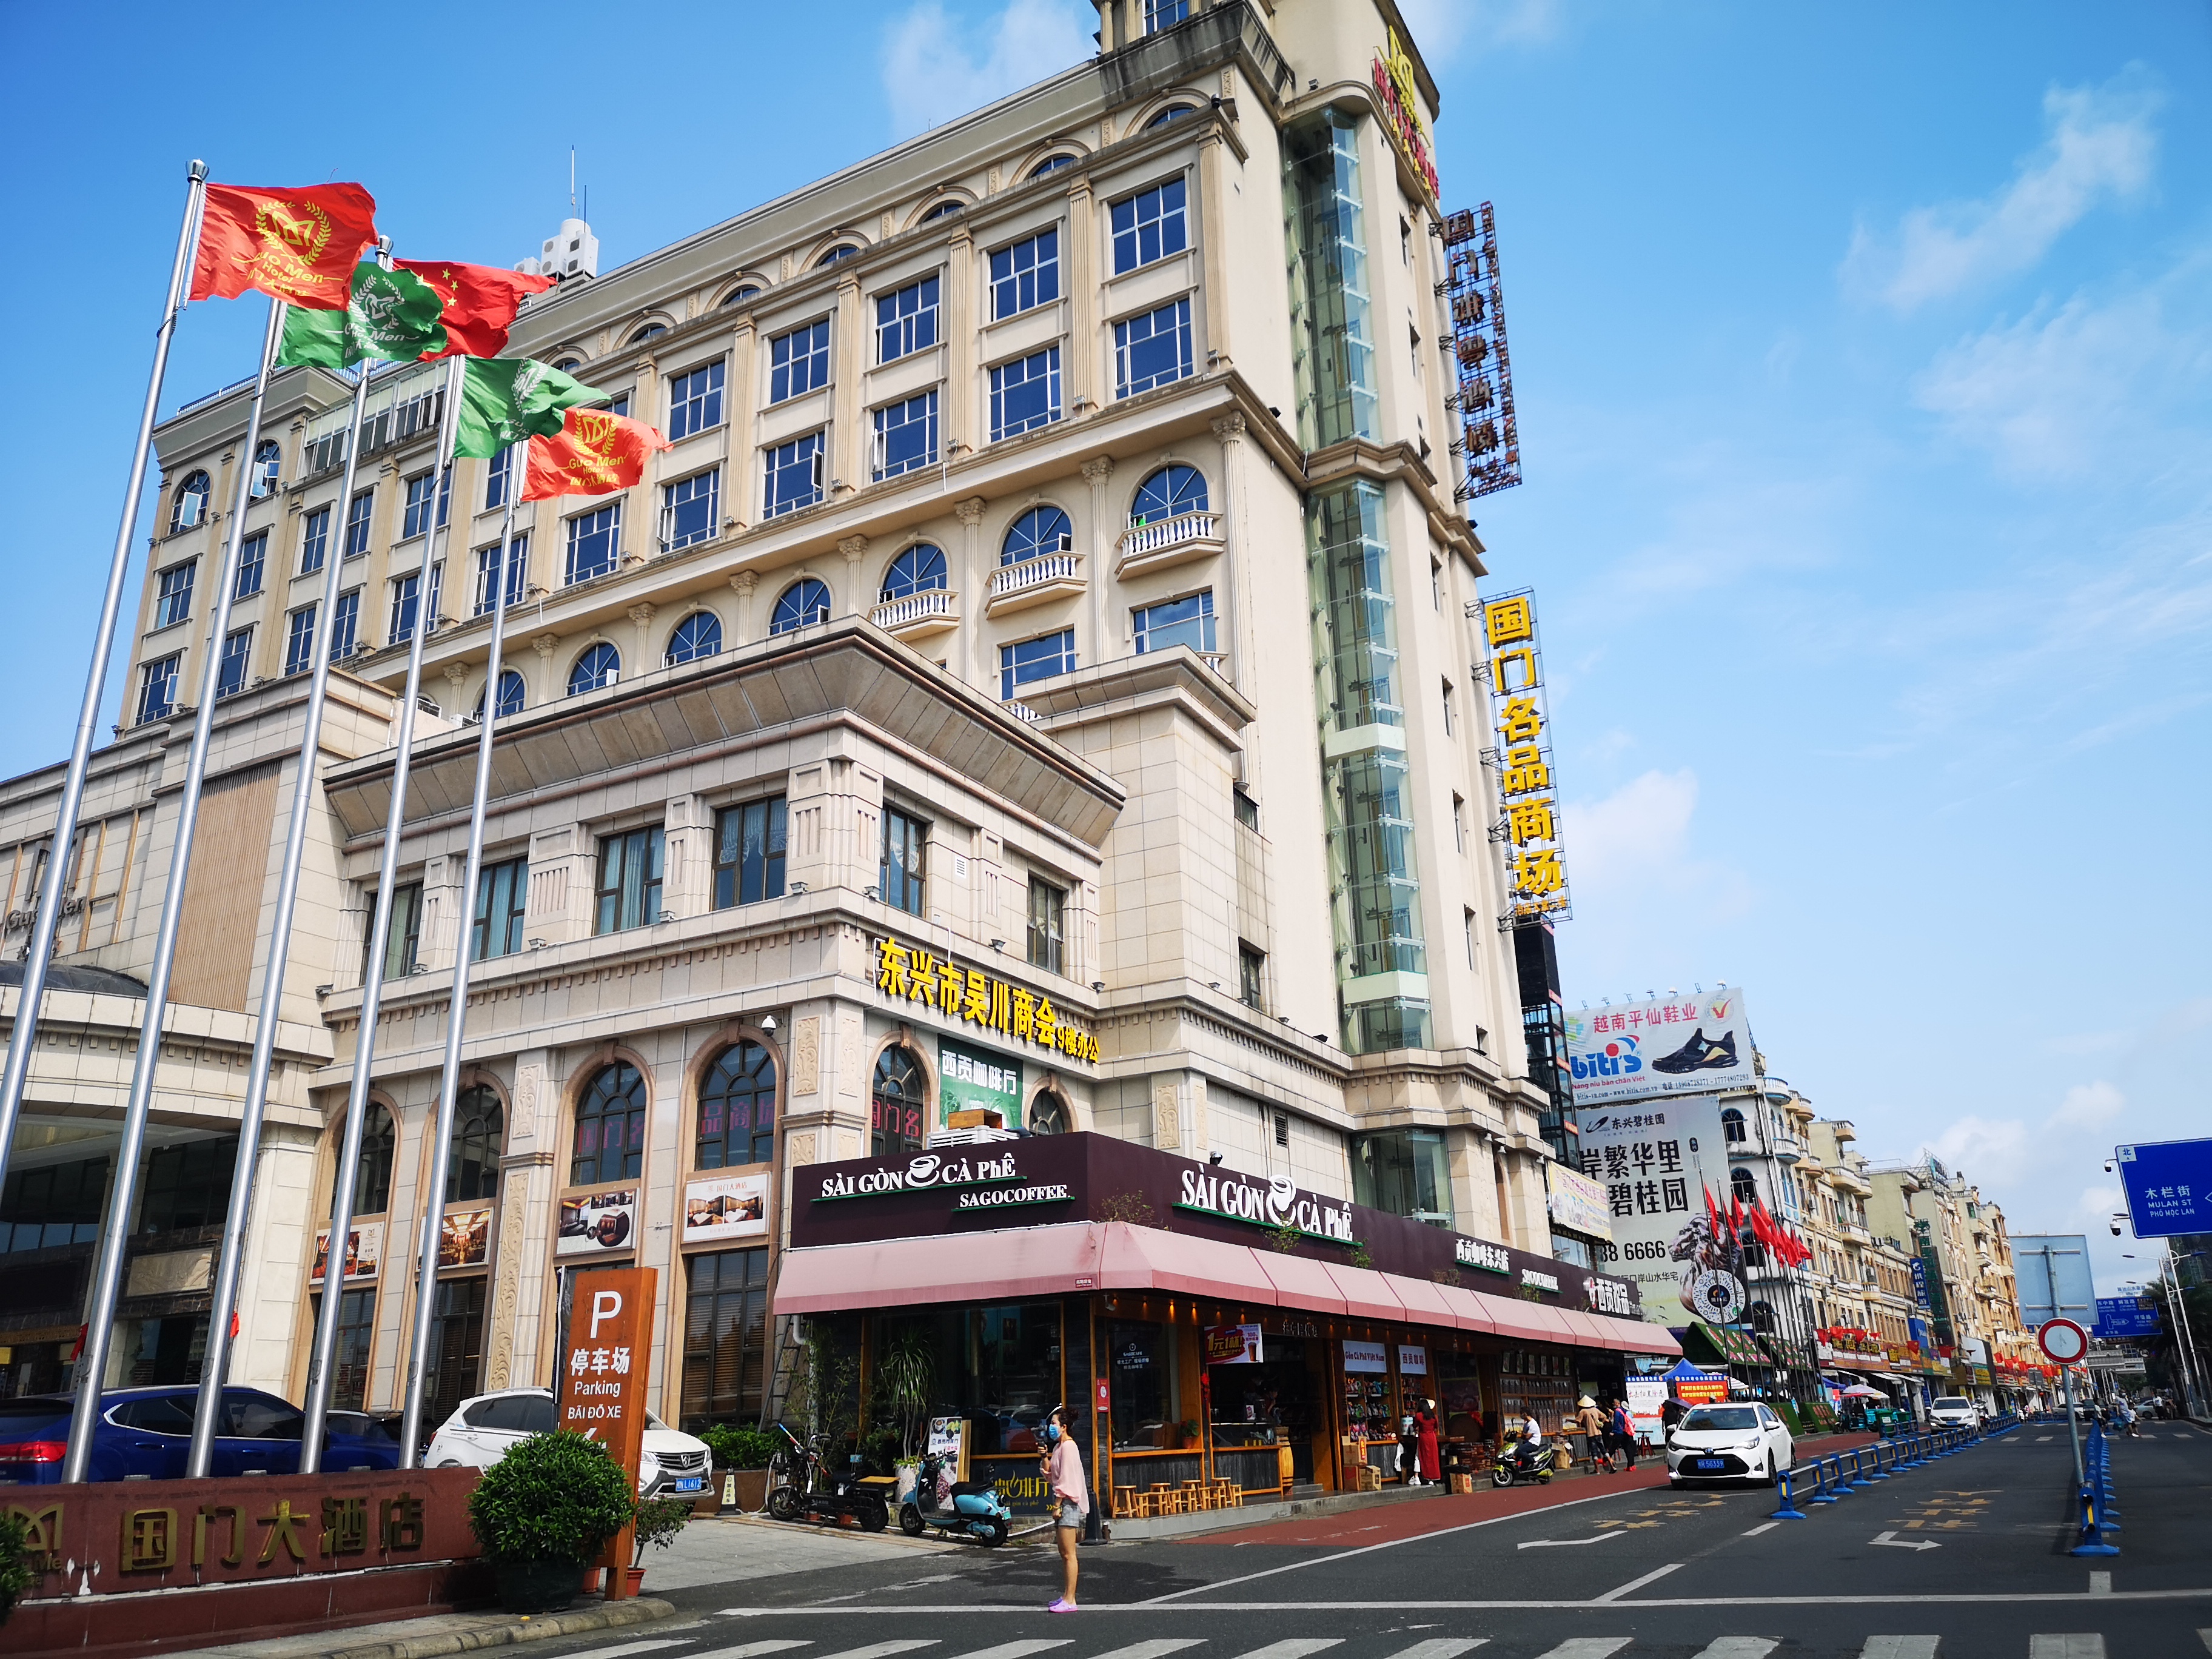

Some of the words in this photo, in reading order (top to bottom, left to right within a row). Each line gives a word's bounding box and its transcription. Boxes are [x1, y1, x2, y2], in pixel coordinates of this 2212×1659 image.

[262, 261, 294, 283] Hotel
[284, 263, 323, 283] Men
[370, 330, 404, 341] Men
[569, 458, 594, 469] Guo
[596, 455, 625, 466] Men
[1484, 596, 1563, 896] 国门名品商场
[1594, 1002, 1698, 1033] 越南平仙鞋业
[942, 1050, 1016, 1095] 西贡咖啡厅
[822, 1170, 855, 1198] SÀI
[859, 1167, 903, 1193] GÒN
[942, 1158, 968, 1184] CÀ
[959, 1184, 1071, 1208] SAGOCOFFEE
[1182, 1163, 1218, 1212] SÀI
[1221, 1175, 1265, 1222] GÒN
[1297, 1193, 1323, 1235] CÀ
[1607, 1178, 1689, 1217] 碧桂园
[2145, 1185, 2190, 1199] 木栏街
[2148, 1200, 2179, 1208] MULAN
[1624, 1240, 1666, 1261] 6666
[590, 1290, 622, 1339] P
[571, 1346, 630, 1376] 停车场
[574, 1380, 621, 1397] Parking
[568, 1404, 585, 1419] BÃI
[588, 1404, 605, 1418] ĐỖ
[606, 1406, 622, 1418] XE
[121, 1494, 423, 1574] 国门大酒店
